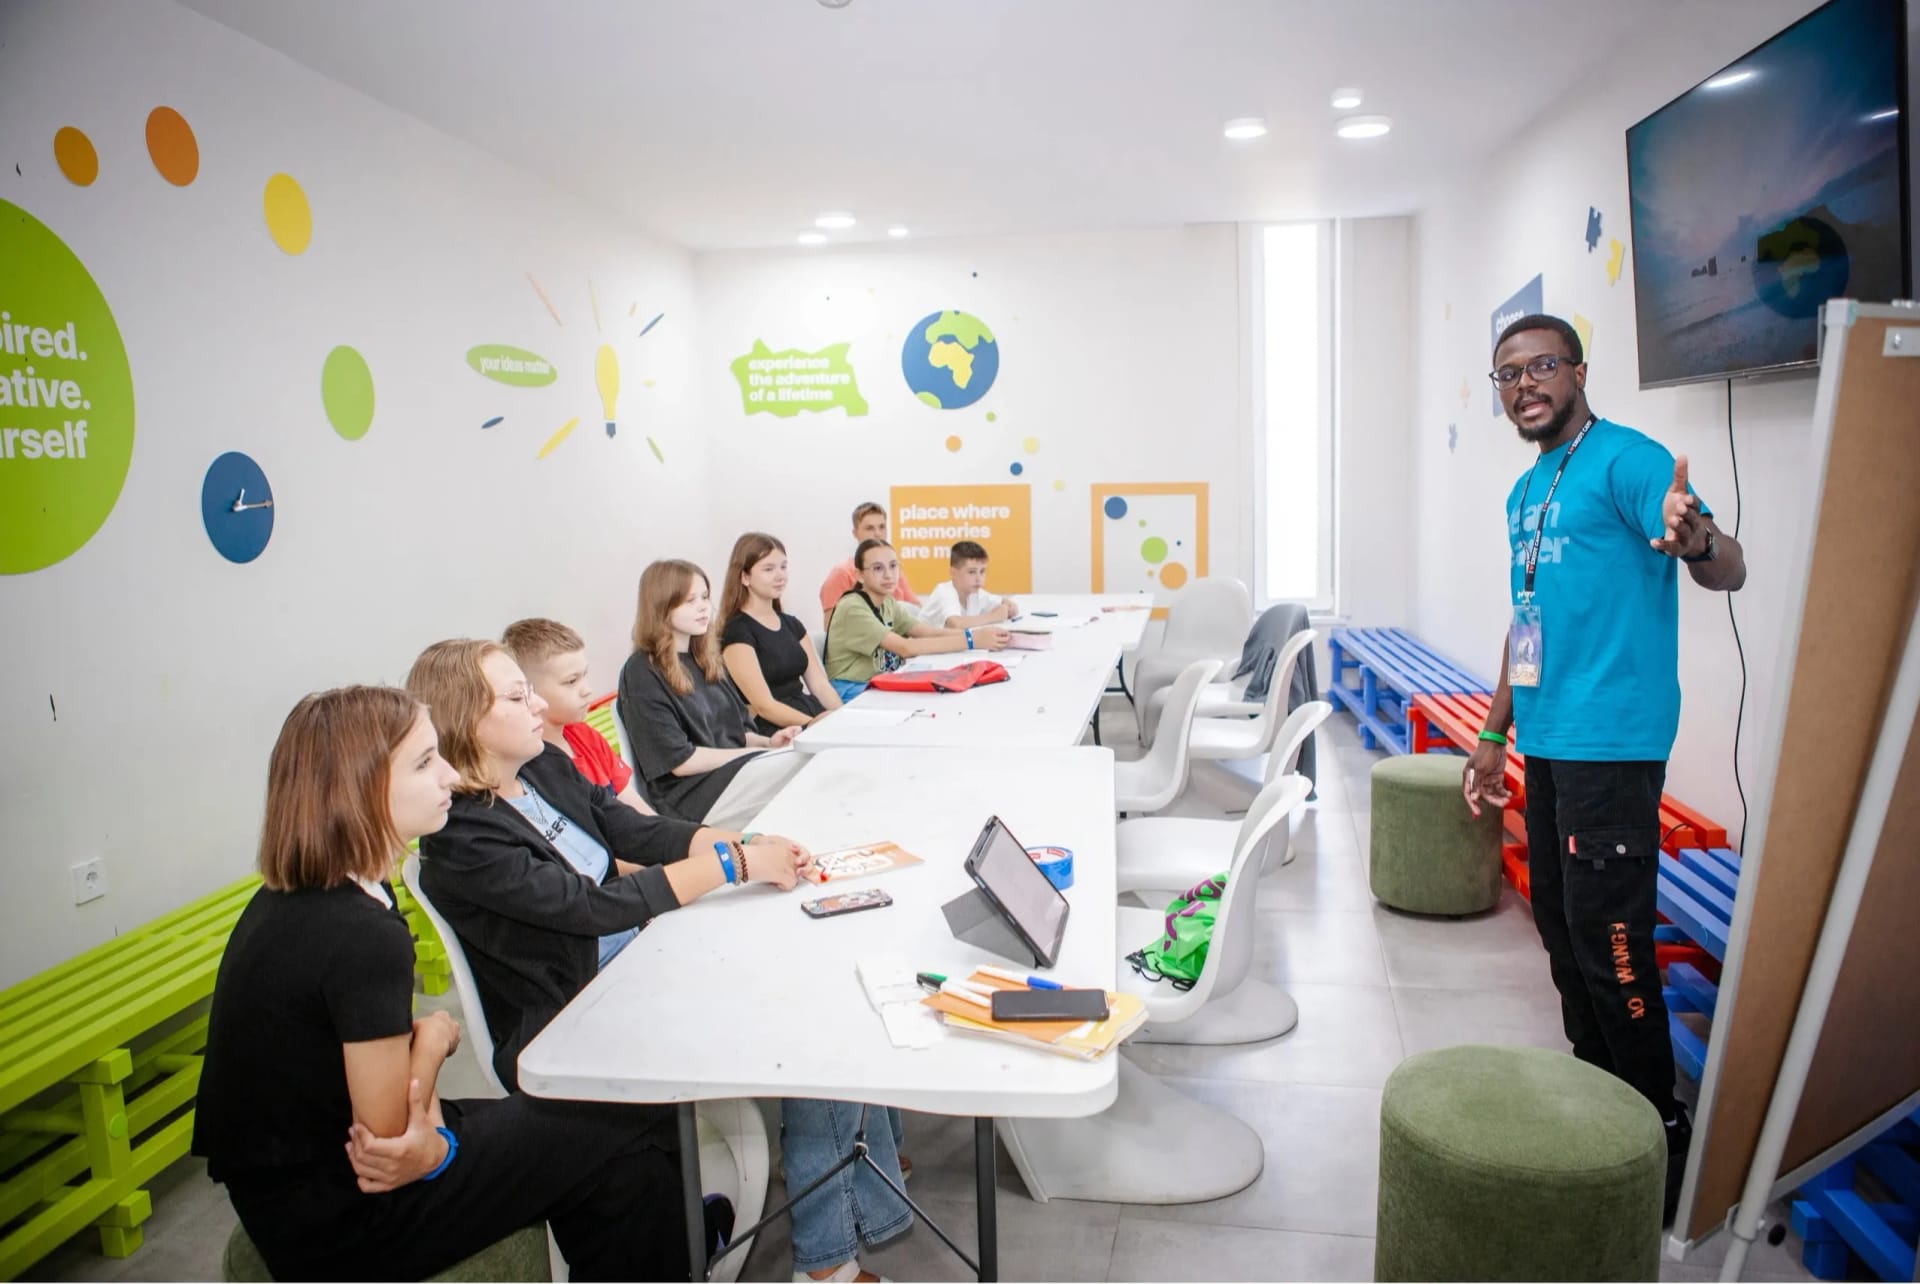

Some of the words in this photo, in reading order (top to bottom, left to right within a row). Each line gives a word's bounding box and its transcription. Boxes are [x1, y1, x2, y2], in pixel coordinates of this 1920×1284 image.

[0, 311, 88, 361] ired.
[480, 357, 500, 374] your
[500, 354, 524, 373] ideas
[748, 355, 830, 371] experience
[749, 372, 773, 386] the
[776, 372, 850, 386] adventure
[749, 387, 764, 402] of
[767, 390, 776, 402] a
[779, 387, 833, 401] lifetime
[0, 420, 88, 459] rself
[899, 503, 949, 524] place
[952, 503, 1010, 519] where
[900, 522, 991, 539] memories
[901, 545, 929, 558] are
